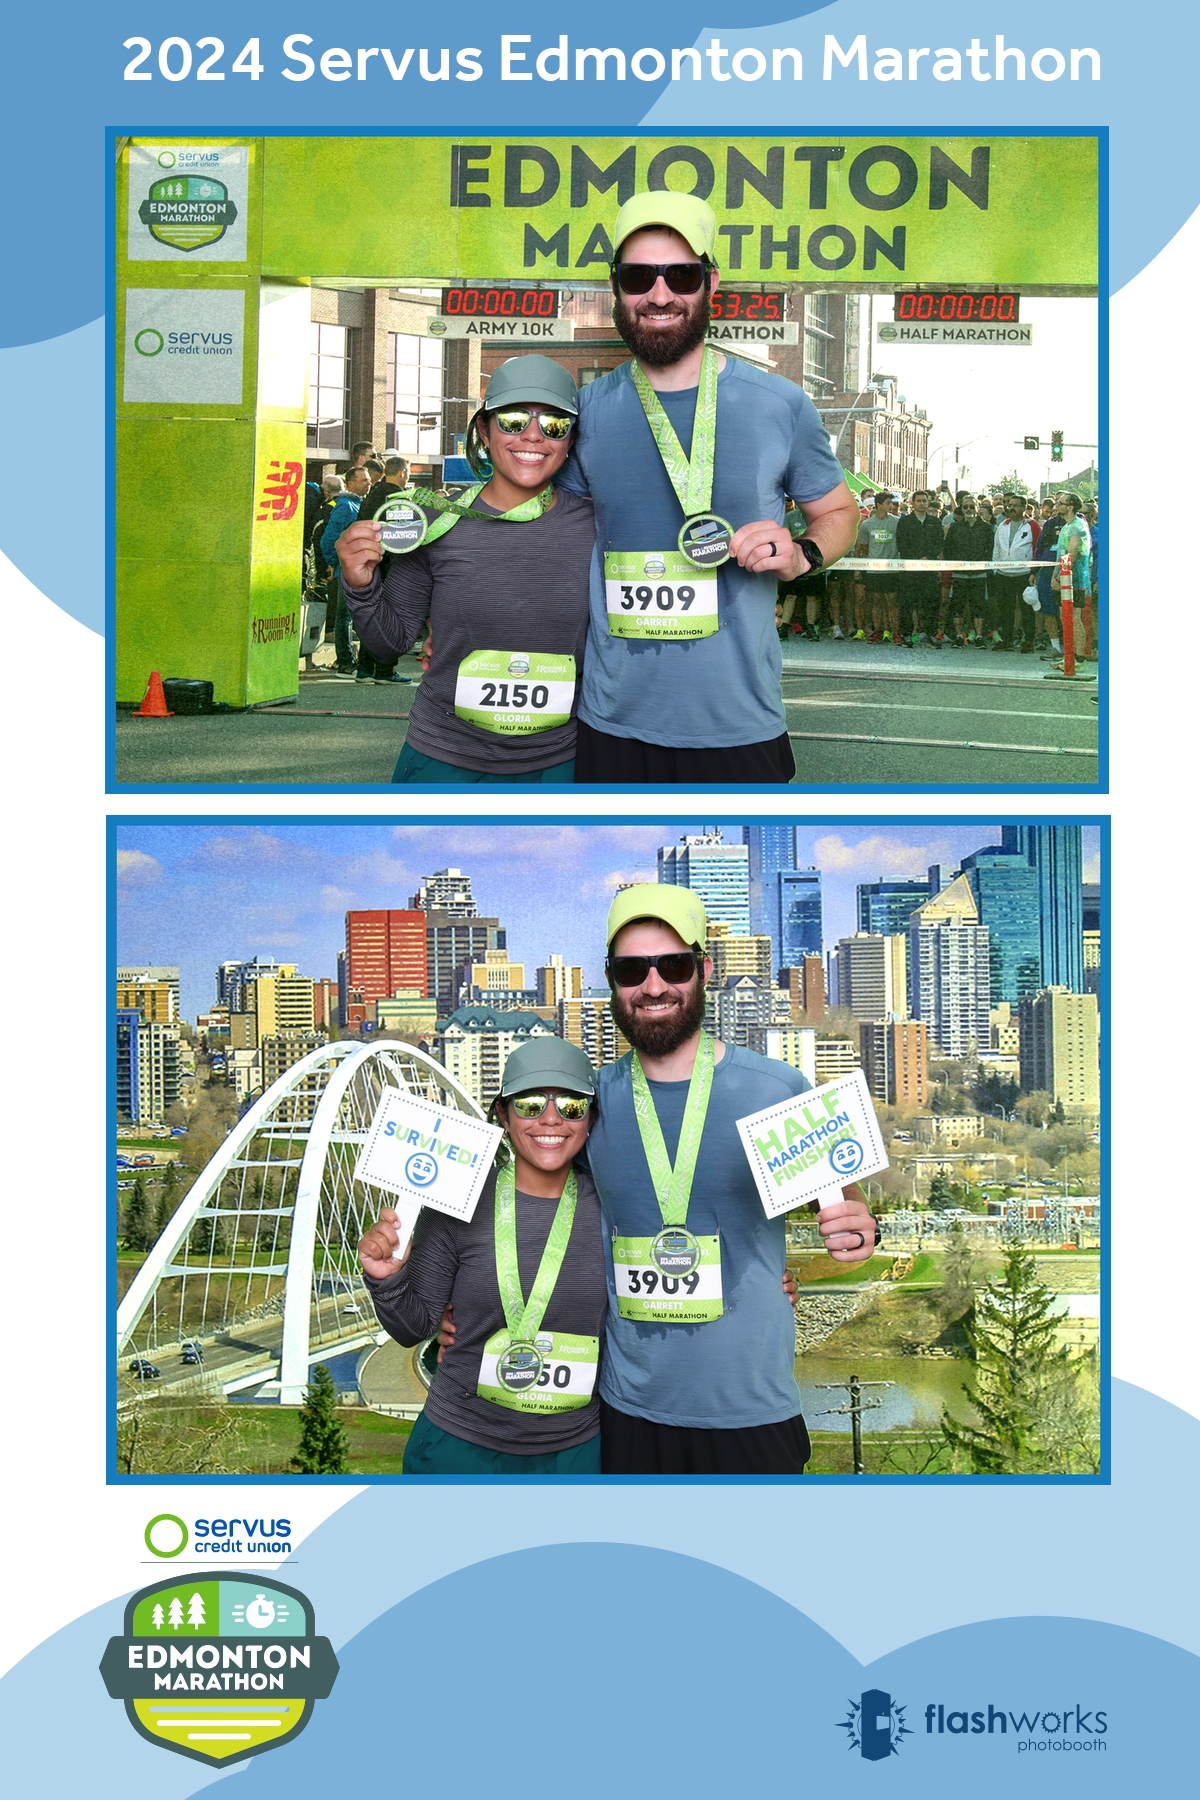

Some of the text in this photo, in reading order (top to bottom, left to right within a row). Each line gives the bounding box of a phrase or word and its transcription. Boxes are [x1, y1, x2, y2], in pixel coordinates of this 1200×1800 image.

[178, 152, 220, 161] servus
[450, 144, 990, 211] EDMONTON
[149, 203, 227, 214] EDMONTON
[160, 214, 215, 222] MARATHON
[523, 222, 906, 271] MATHON
[465, 321, 554, 337] ARMY 10K
[707, 326, 785, 340] RATHON
[900, 328, 1031, 341] HALF MARATHON
[168, 332, 233, 345] servus
[167, 345, 233, 355] credit union
[620, 585, 696, 611] 3909
[635, 617, 678, 627] GARRETT
[479, 682, 549, 709] 2150
[493, 713, 531, 723] GLORIA
[433, 1118, 442, 1133] I
[754, 1088, 840, 1162] HALF
[383, 1121, 479, 1168] SURVIVED!
[766, 1111, 850, 1173] MARATHON
[772, 1123, 858, 1187] FINISHER!
[628, 1269, 700, 1295] 3909
[643, 1301, 684, 1310] GARRETT
[535, 1364, 571, 1388] 50
[516, 1392, 553, 1402] GLORIA
